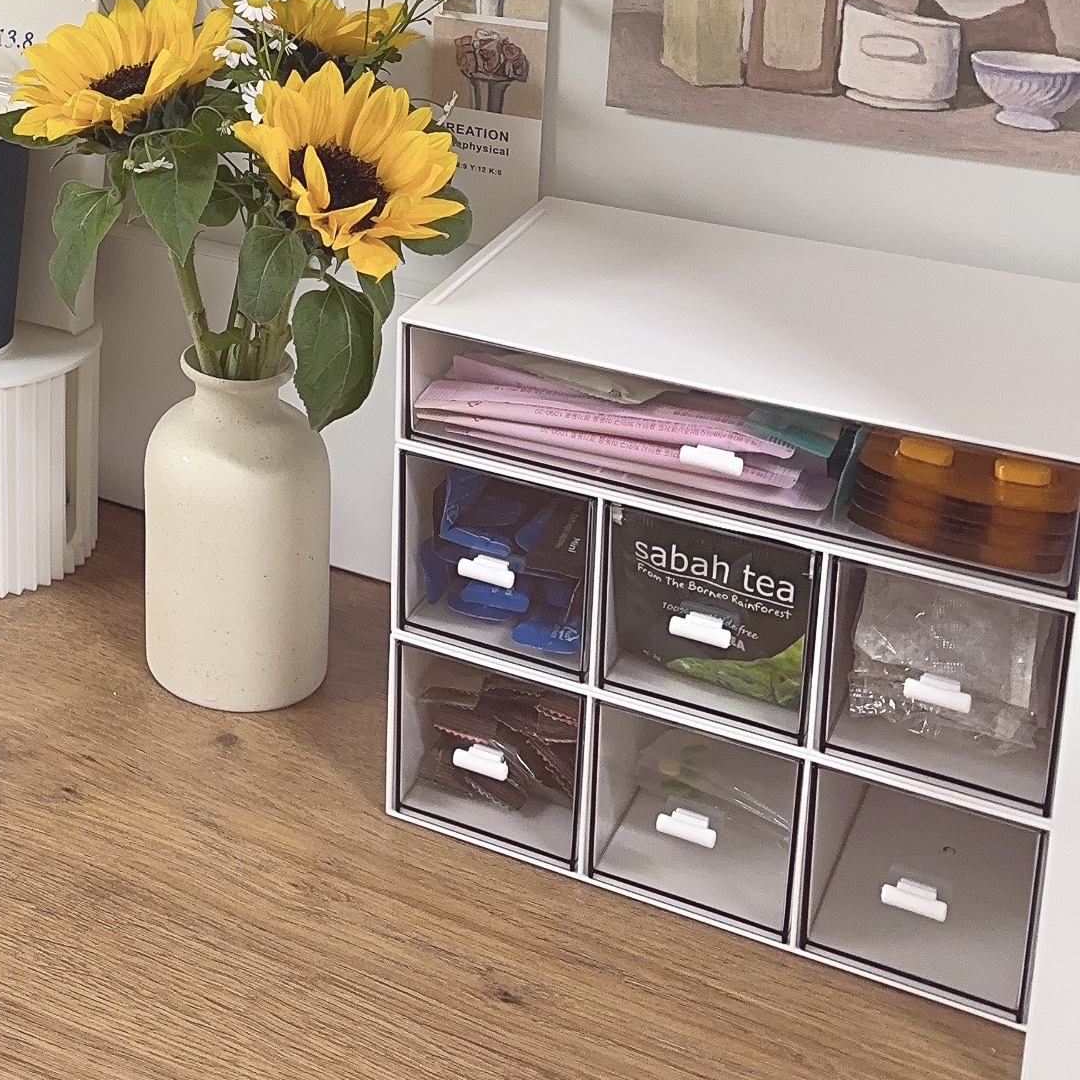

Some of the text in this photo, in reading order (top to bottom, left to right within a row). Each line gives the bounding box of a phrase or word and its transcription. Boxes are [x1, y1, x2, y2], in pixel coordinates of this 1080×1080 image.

[446, 122, 510, 142] REATION
[634, 540, 795, 604] sabah tea
[636, 562, 662, 583] From
[665, 576, 685, 590] The
[687, 580, 729, 601] Borneo
[737, 624, 760, 641] free
[730, 635, 746, 653] EA
